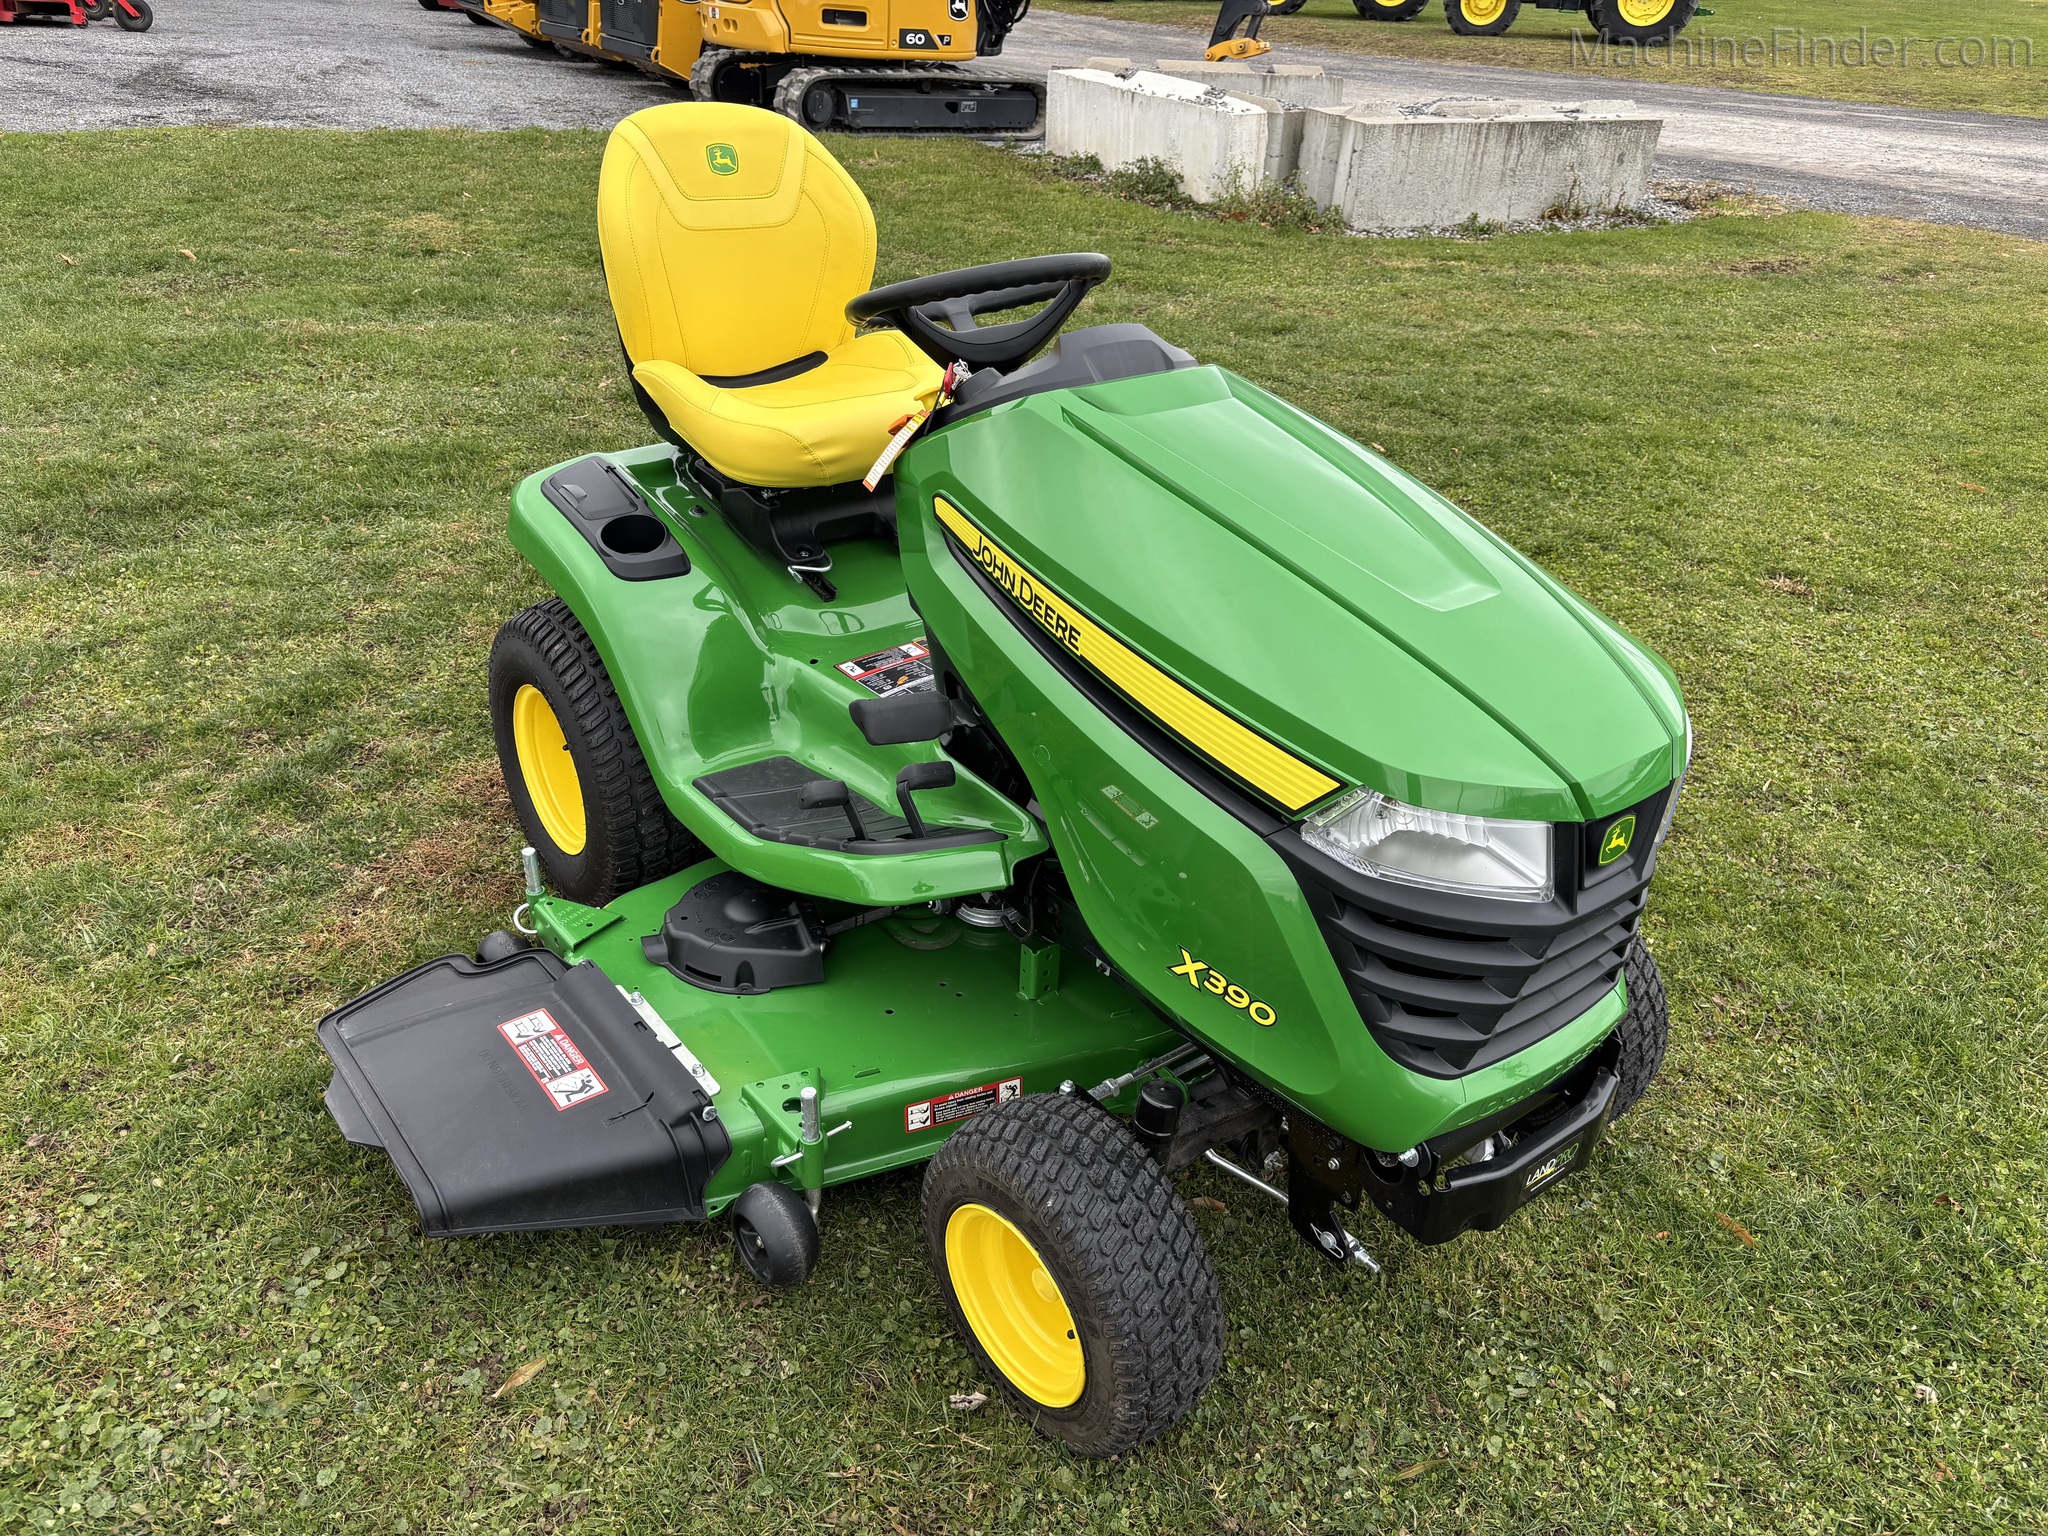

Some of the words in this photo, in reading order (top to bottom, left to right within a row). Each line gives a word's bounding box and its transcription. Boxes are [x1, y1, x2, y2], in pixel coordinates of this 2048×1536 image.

[905, 33, 925, 45] 60
[973, 535, 1016, 592] JOHN
[1020, 576, 1082, 650] DEERE
[1168, 946, 1277, 1026] X390
[559, 1039, 585, 1065] DANGER
[954, 1087, 983, 1099] DANGER
